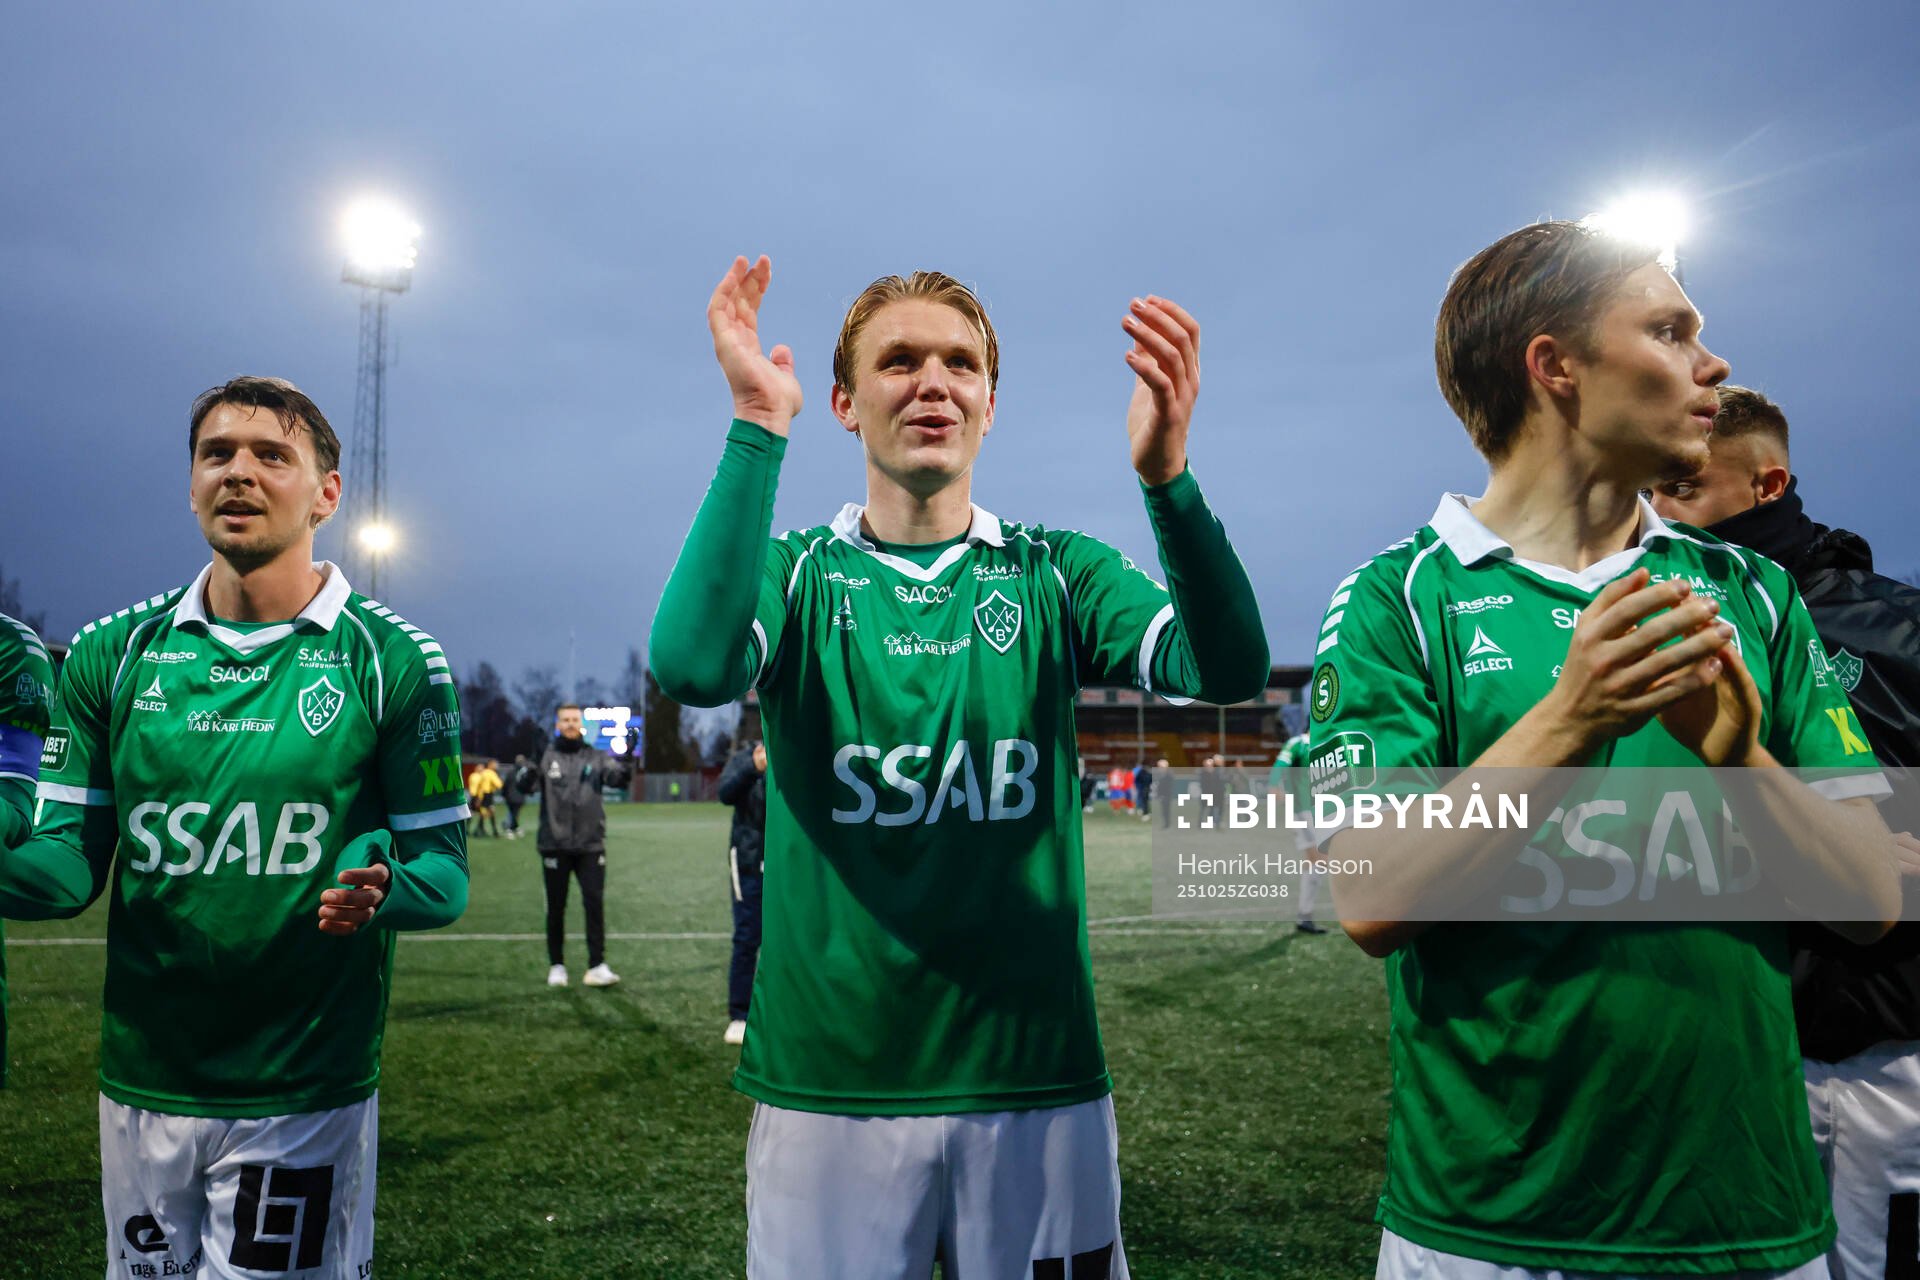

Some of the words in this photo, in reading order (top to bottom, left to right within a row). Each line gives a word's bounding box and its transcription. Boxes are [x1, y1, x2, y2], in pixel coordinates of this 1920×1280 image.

[1447, 595, 1514, 611] ARSCO
[1464, 657, 1514, 677] SELECT
[133, 699, 167, 712] SELECT
[212, 721, 239, 732] KARL
[241, 720, 275, 732] HEDIN
[43, 736, 67, 754] IBET
[1309, 744, 1365, 783] NIBET
[831, 738, 1039, 827] SSAB
[128, 801, 331, 877] SSAB
